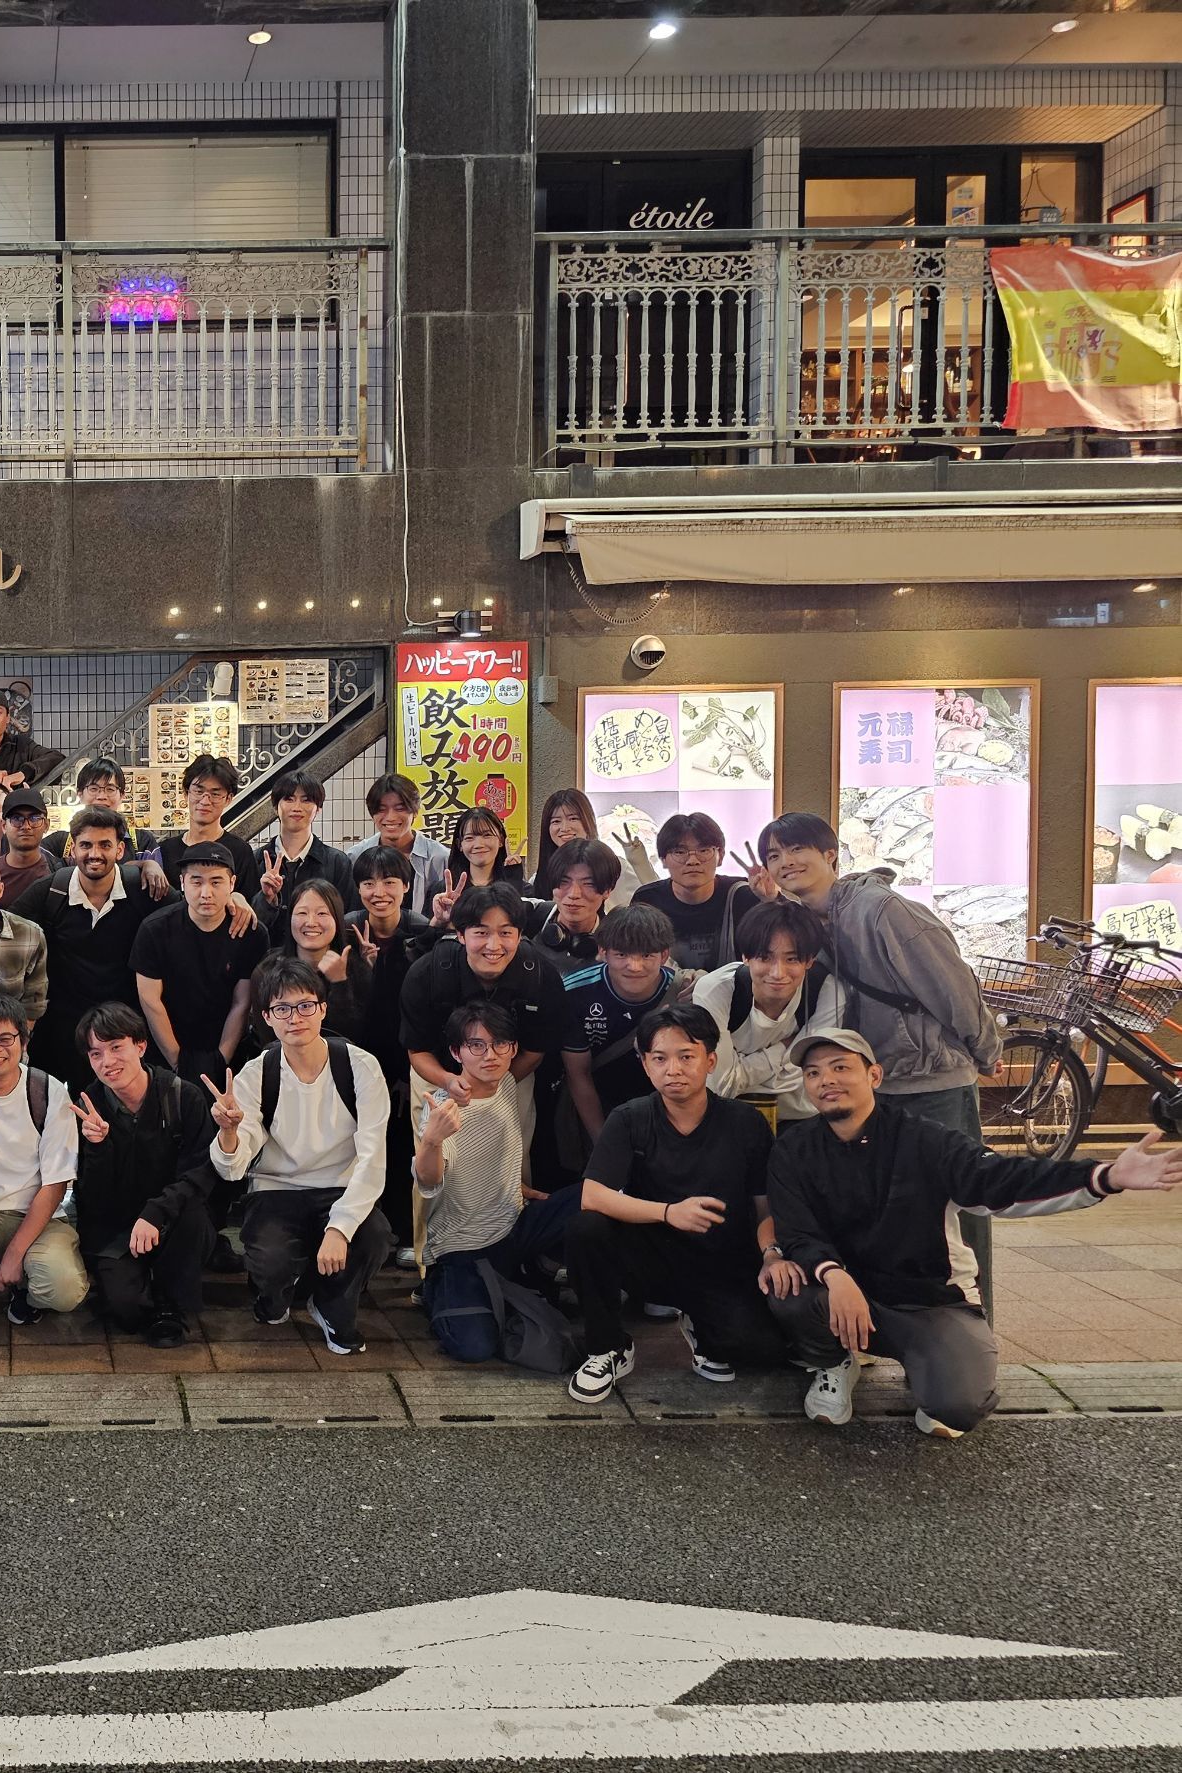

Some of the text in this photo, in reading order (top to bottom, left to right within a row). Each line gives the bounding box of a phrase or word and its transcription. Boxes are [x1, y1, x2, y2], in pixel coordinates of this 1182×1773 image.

[629, 197, 714, 229] étoile
[403, 649, 522, 676] ハッピーアワー!!
[462, 684, 490, 693] 夕方5時
[406, 693, 419, 760] 生ビール付き
[470, 713, 507, 731] 1時間
[857, 711, 914, 738] 元禄
[452, 731, 512, 763] 490
[511, 752, 522, 763] 円
[858, 739, 913, 765] 寿司
